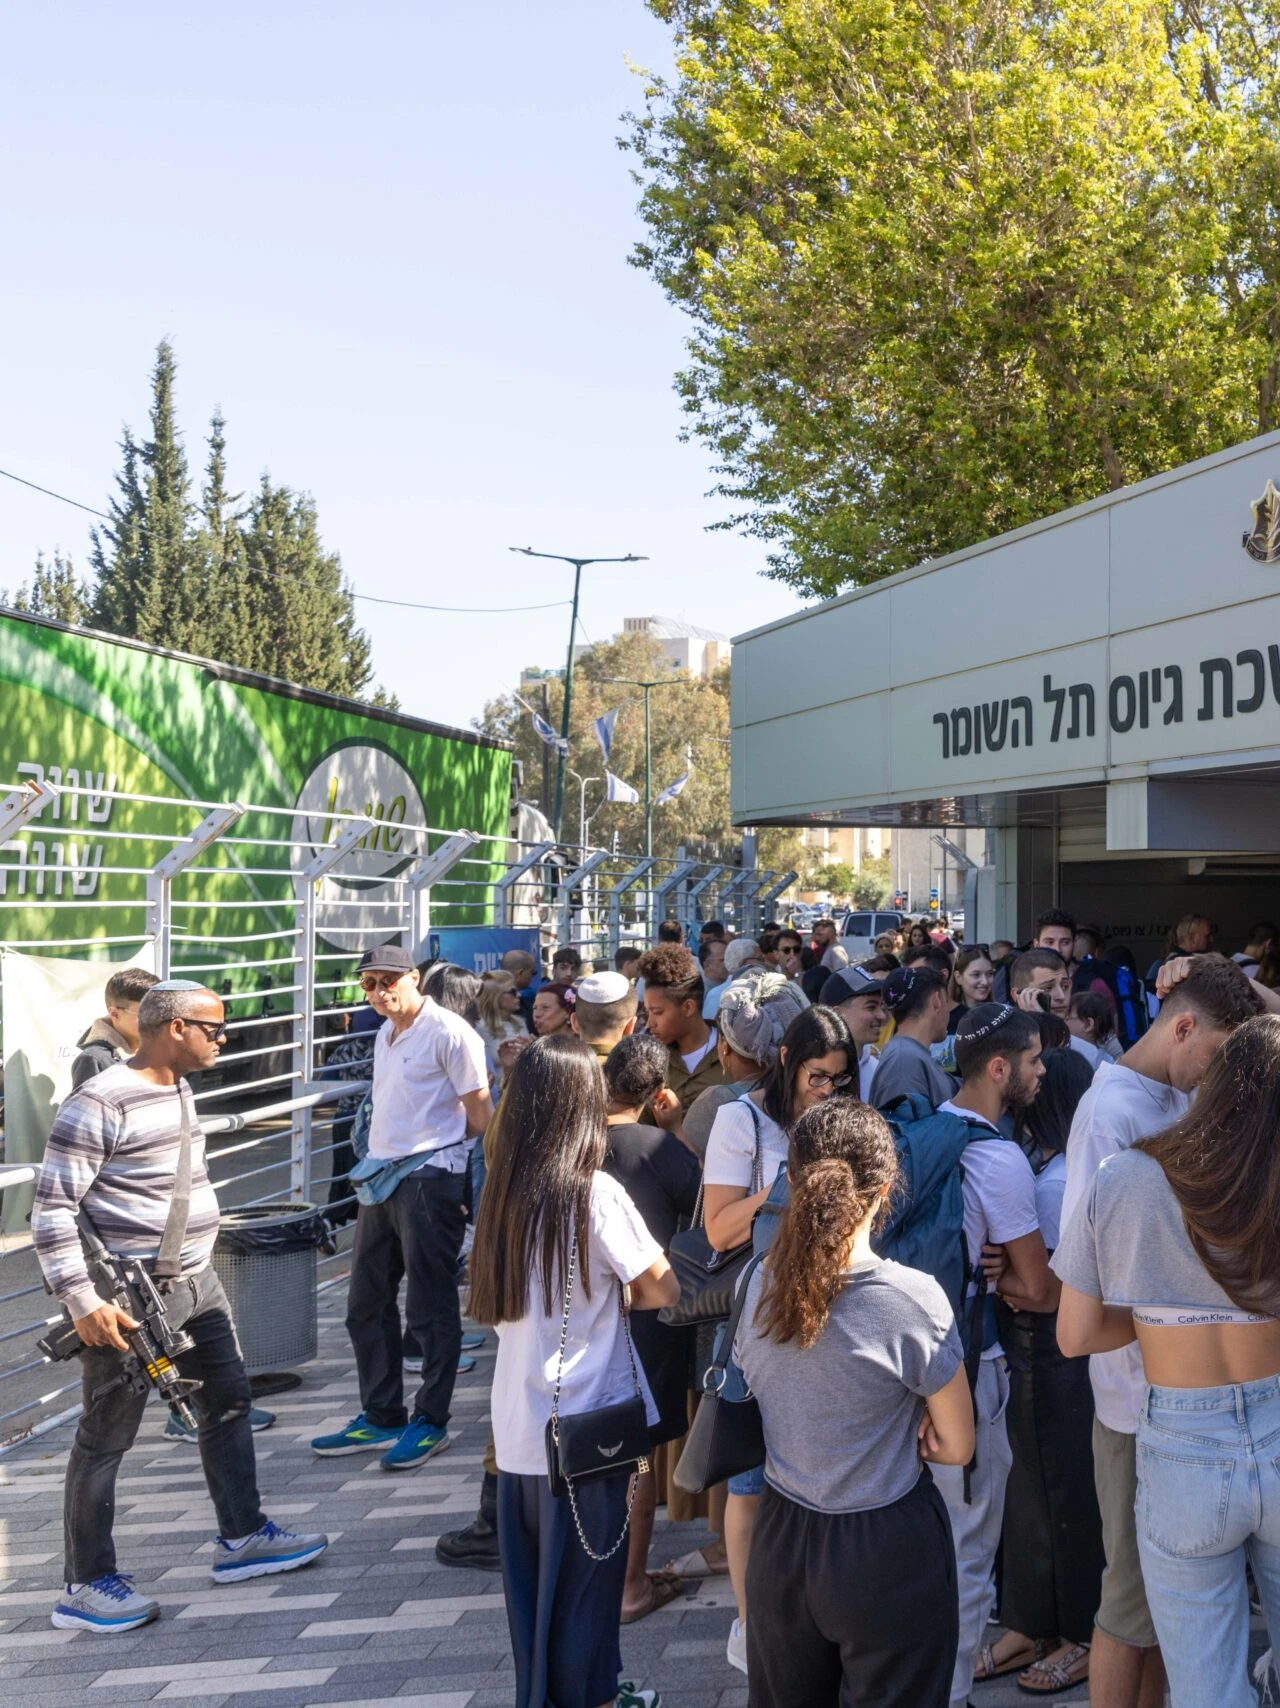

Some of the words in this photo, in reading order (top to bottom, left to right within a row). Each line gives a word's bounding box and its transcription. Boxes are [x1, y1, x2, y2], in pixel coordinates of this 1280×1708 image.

[933, 696, 1033, 759] השומר
[1043, 674, 1095, 743] תל
[1108, 664, 1184, 734] גיוס
[1177, 1314, 1209, 1325] Calvin
[1209, 1312, 1233, 1322] Klein
